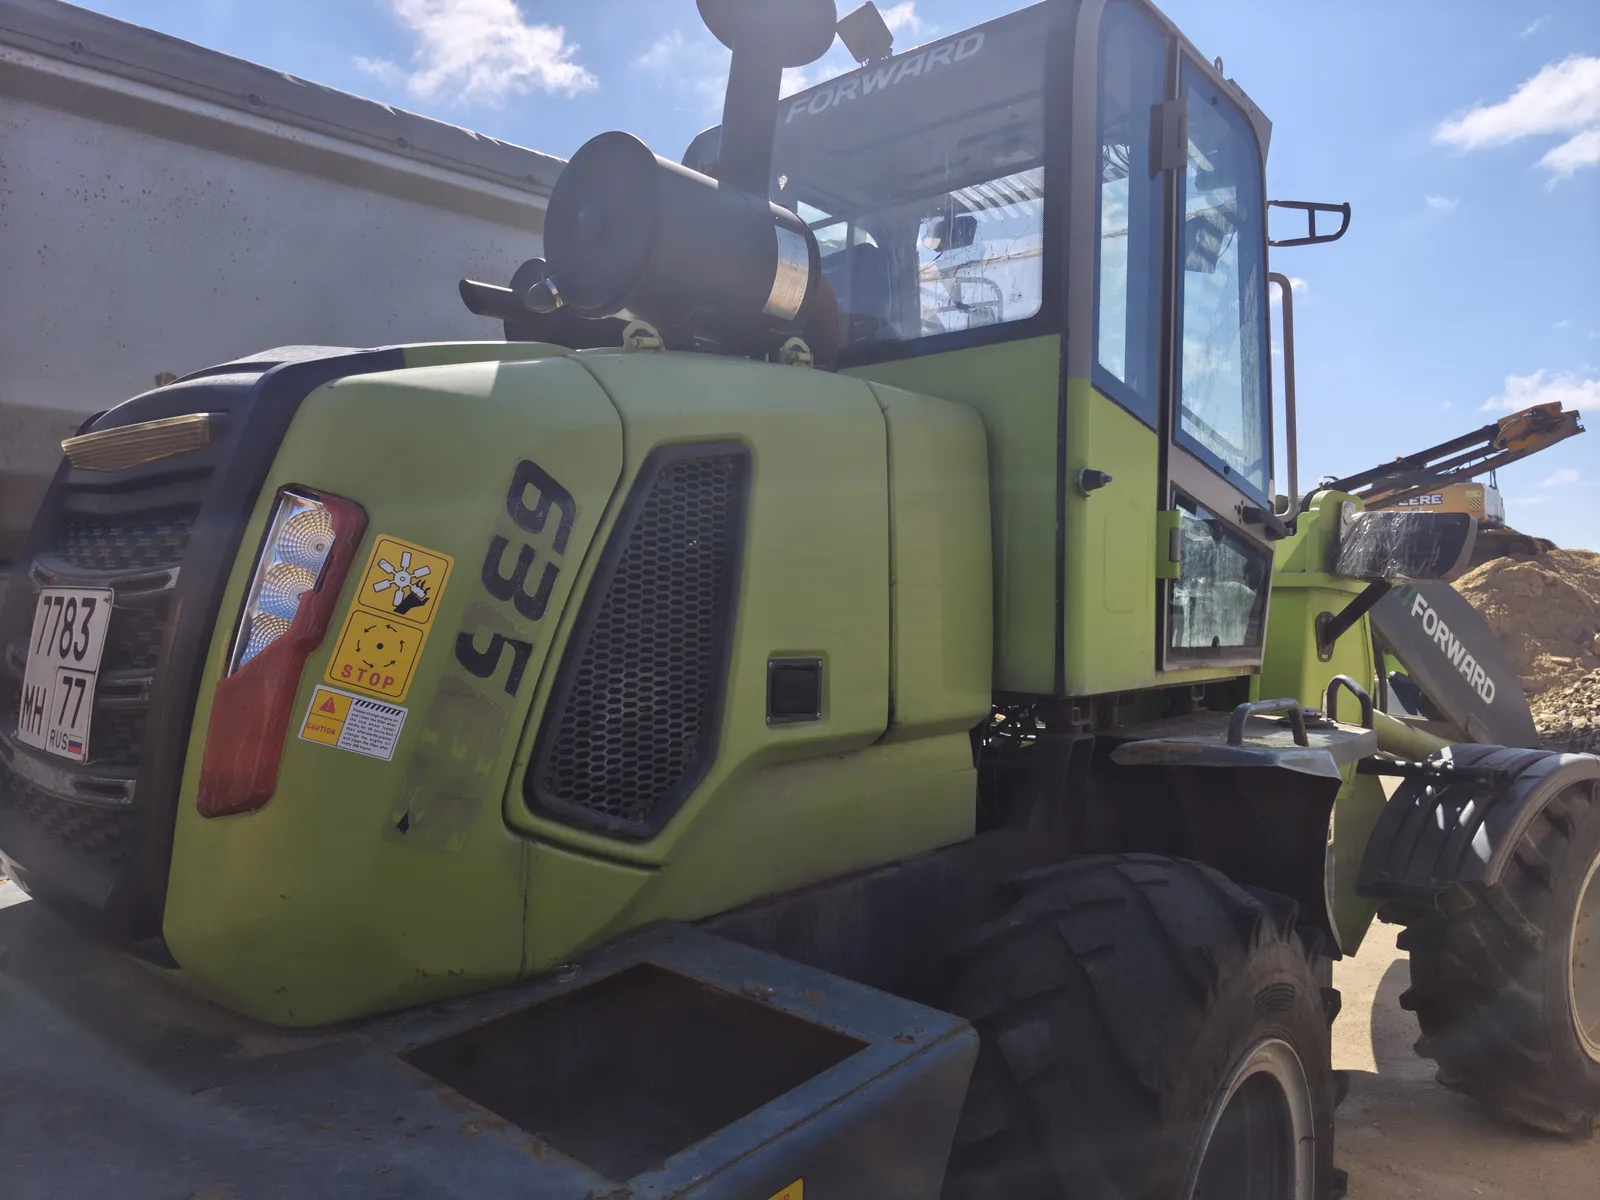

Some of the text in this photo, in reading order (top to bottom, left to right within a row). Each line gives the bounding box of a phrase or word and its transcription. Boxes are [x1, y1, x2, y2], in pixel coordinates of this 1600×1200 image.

[785, 32, 986, 124] FORWARD
[1391, 494, 1442, 507] ERE
[454, 459, 577, 698] 935
[36, 596, 97, 661] 7783
[1411, 593, 1496, 704] FORWARD
[58, 676, 87, 729] 77
[341, 664, 394, 689] STOP
[50, 729, 68, 751] RUS
[306, 722, 336, 736] CAUTION
